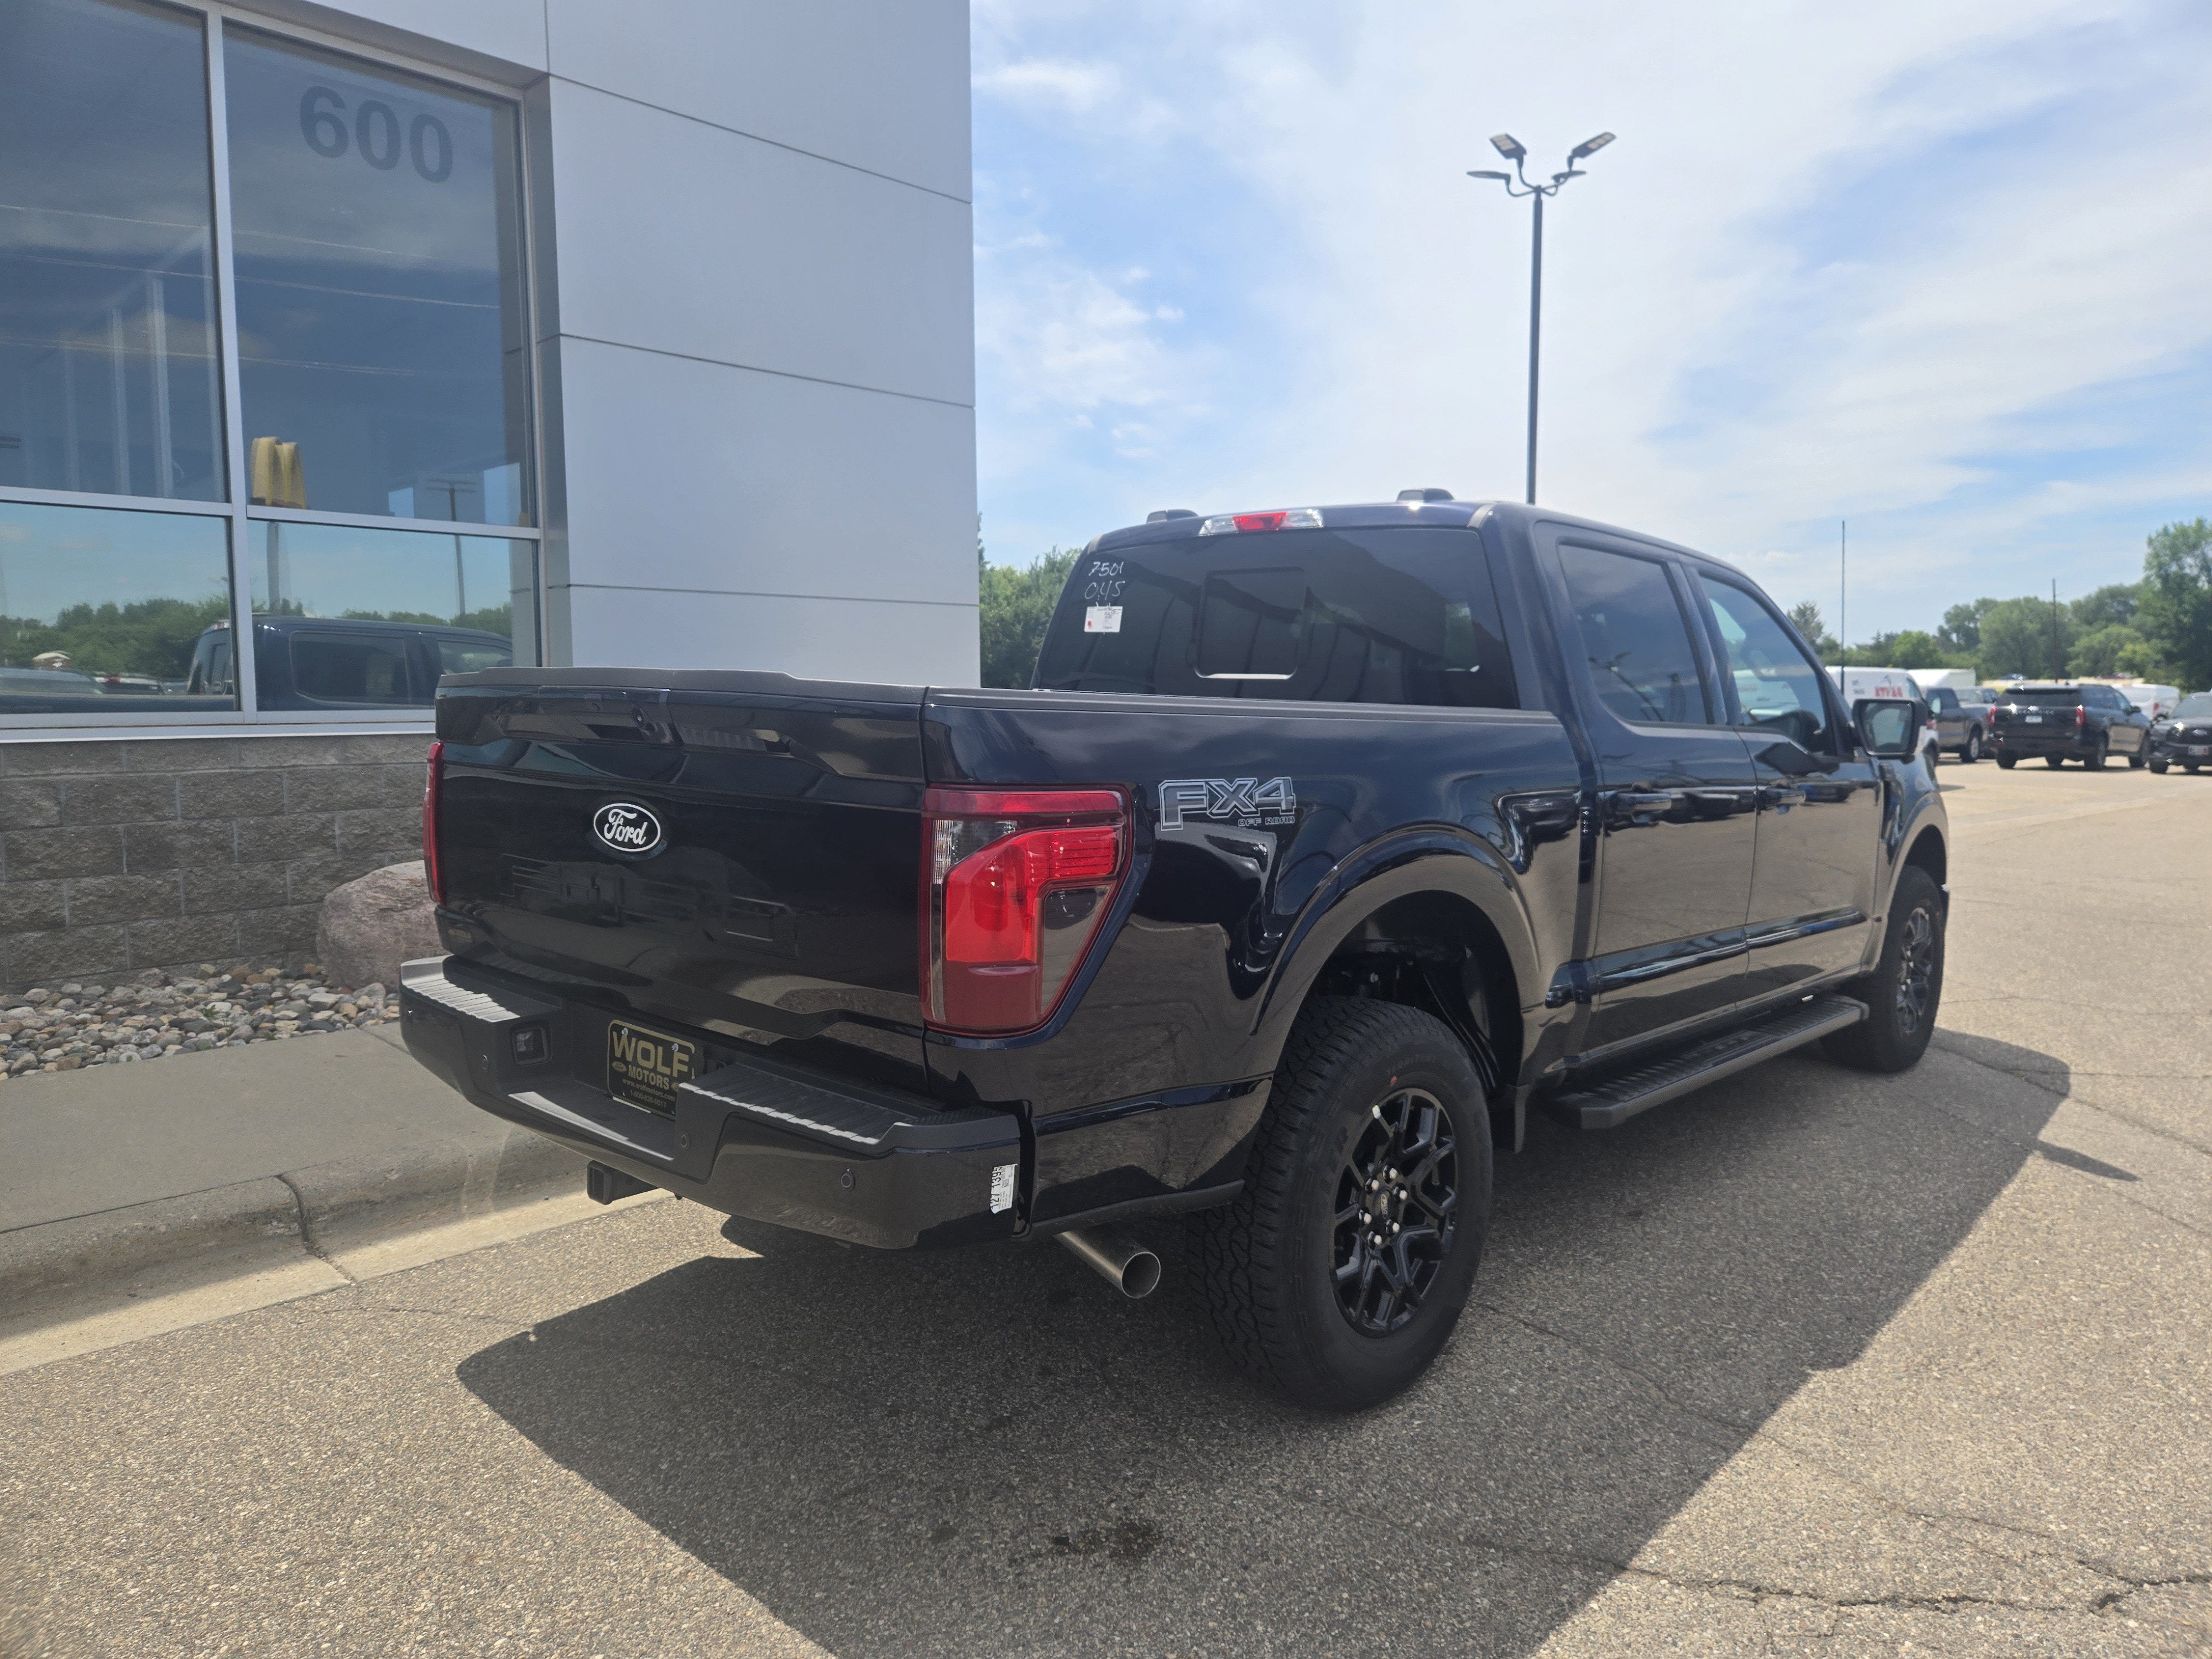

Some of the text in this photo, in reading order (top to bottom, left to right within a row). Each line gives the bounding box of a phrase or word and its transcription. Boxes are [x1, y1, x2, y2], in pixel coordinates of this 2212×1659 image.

[300, 85, 453, 183] 600
[1088, 561, 1124, 577] 7501
[1158, 776, 1296, 831] FX4
[1238, 816, 1295, 827] OFF ROAD
[604, 808, 648, 845] Ford
[612, 1030, 689, 1078] WOLF
[628, 1064, 670, 1091] MOTORS
